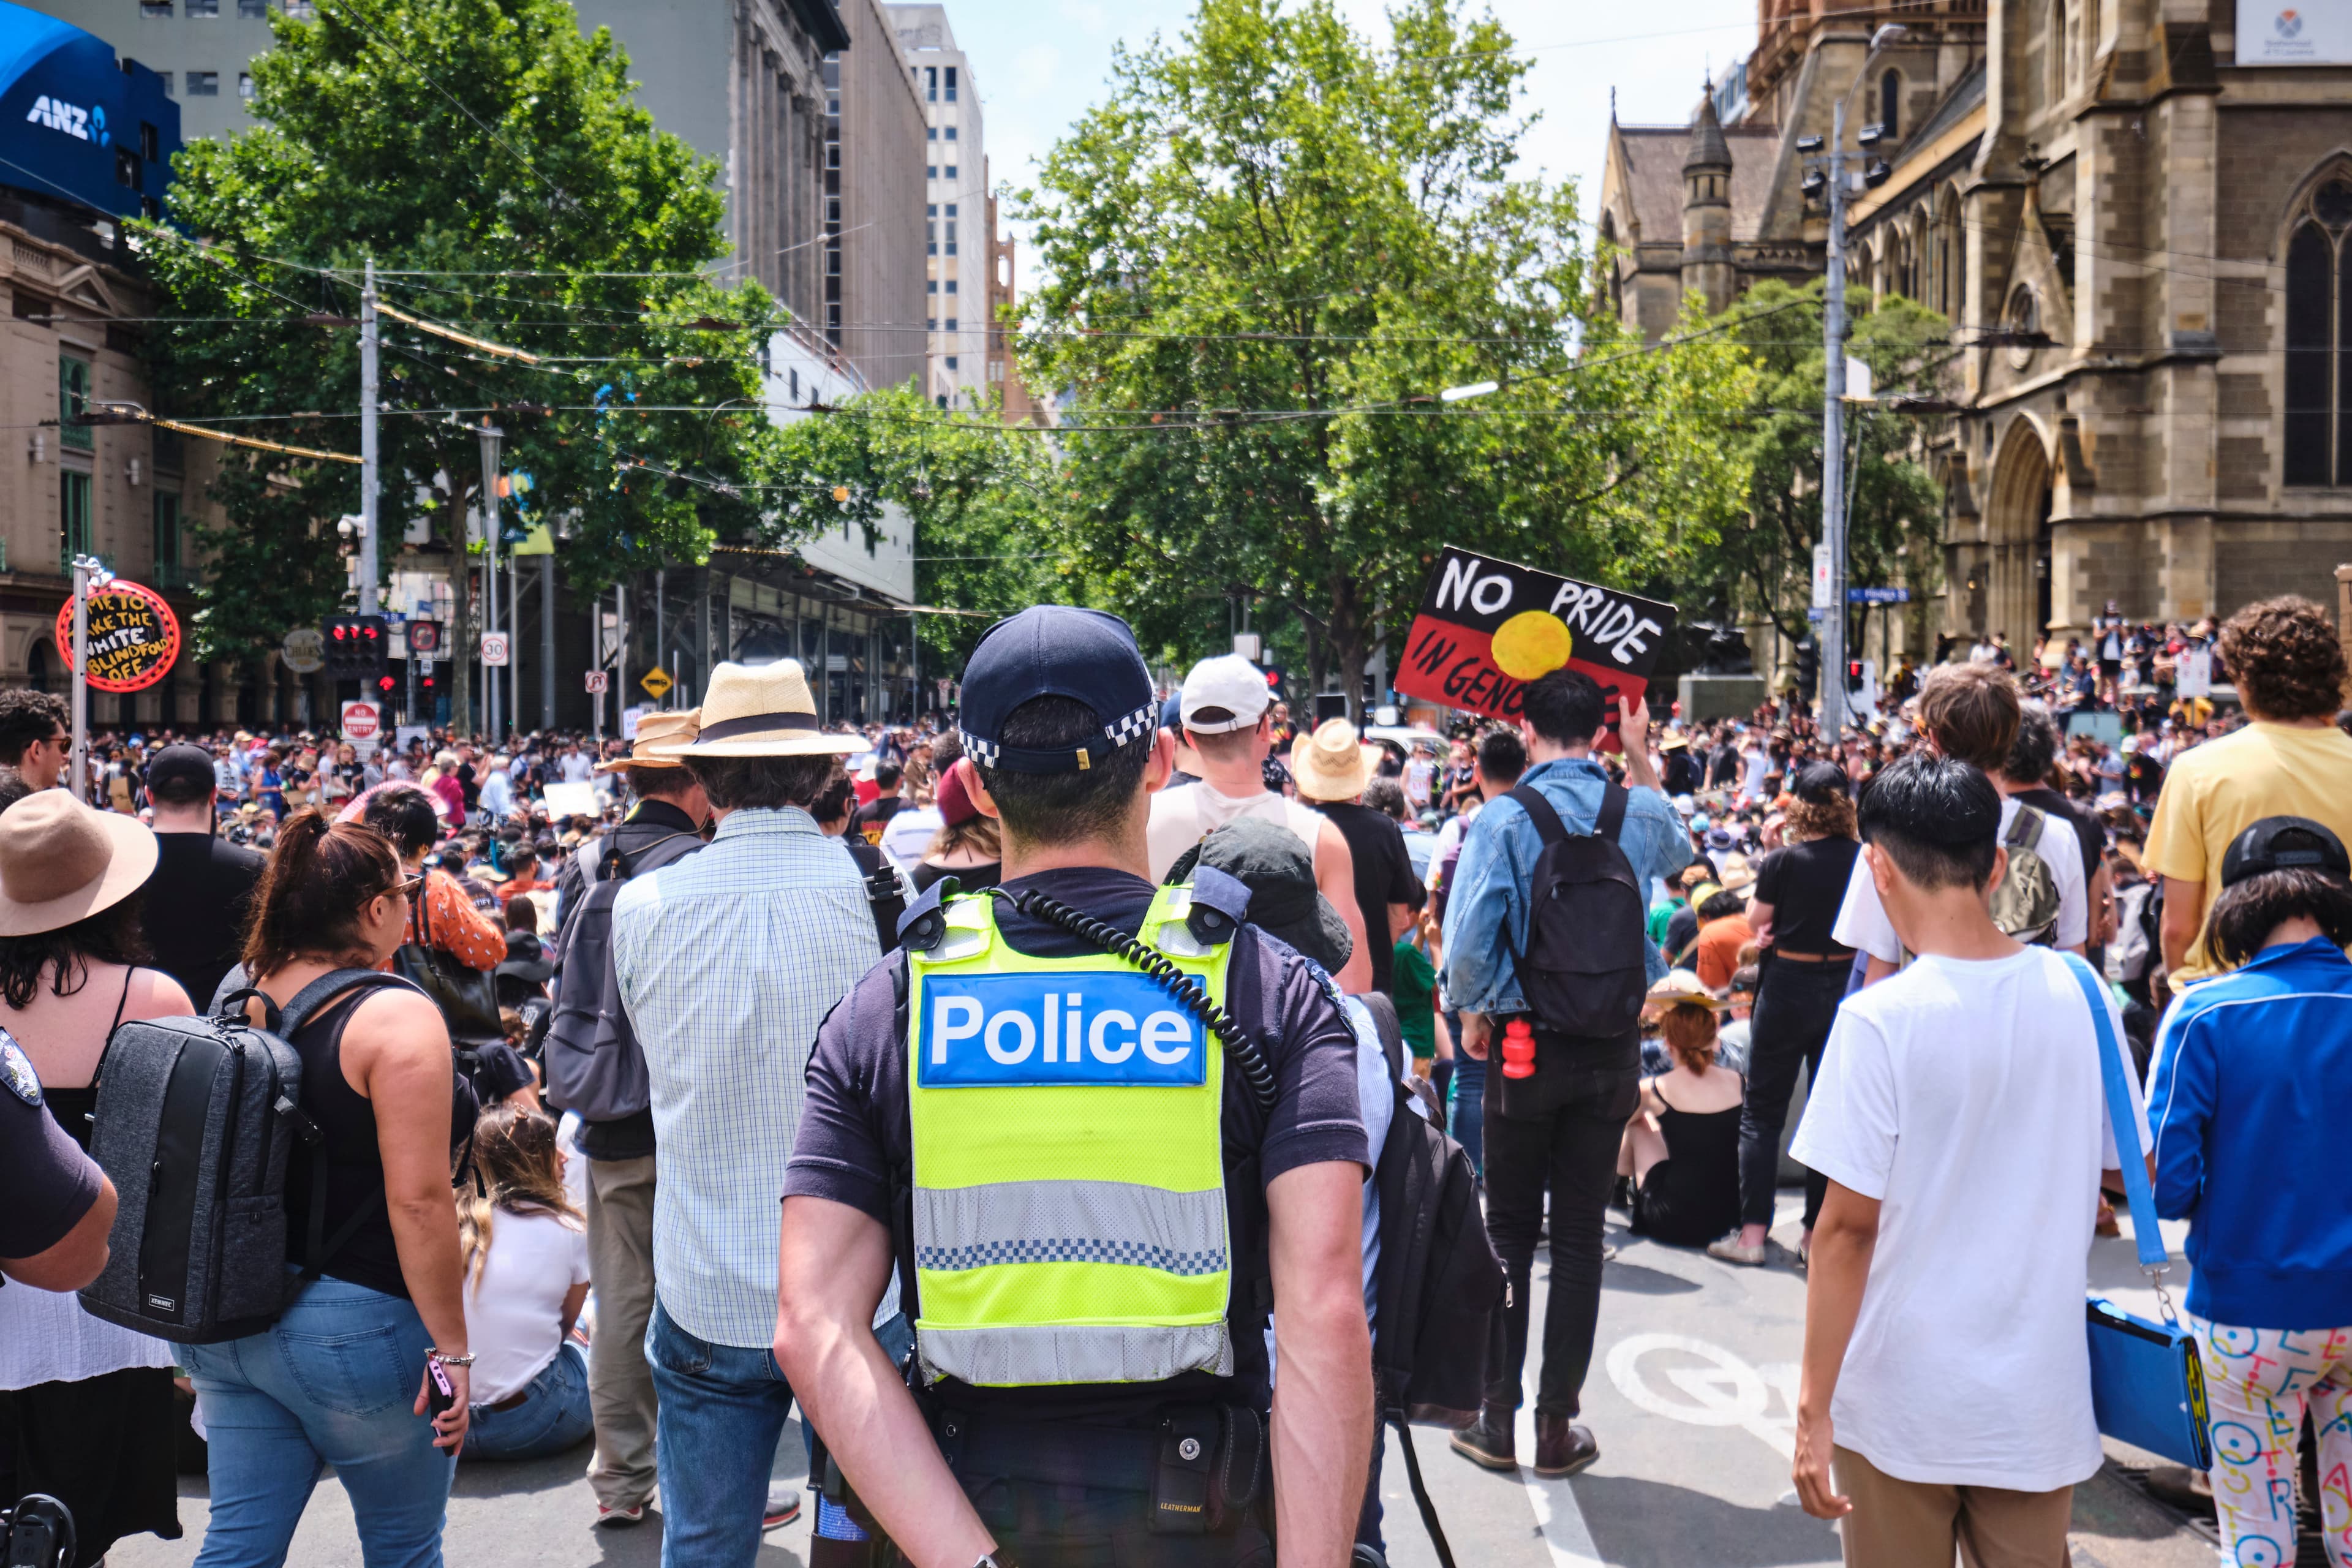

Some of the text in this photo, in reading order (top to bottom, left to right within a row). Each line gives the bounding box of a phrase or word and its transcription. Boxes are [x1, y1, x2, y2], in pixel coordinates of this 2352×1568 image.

[26, 94, 88, 141] ANZ
[116, 594, 145, 611] TO
[1436, 557, 1662, 665] NO PRIDE
[116, 612, 153, 627] THE
[87, 638, 169, 676] BLINDFOLD
[486, 644, 503, 656] 30
[1411, 629, 1457, 676] IN
[108, 658, 142, 682] OFF
[931, 992, 1192, 1065] Police
[1161, 1502, 1201, 1512] LEATHERMAN
